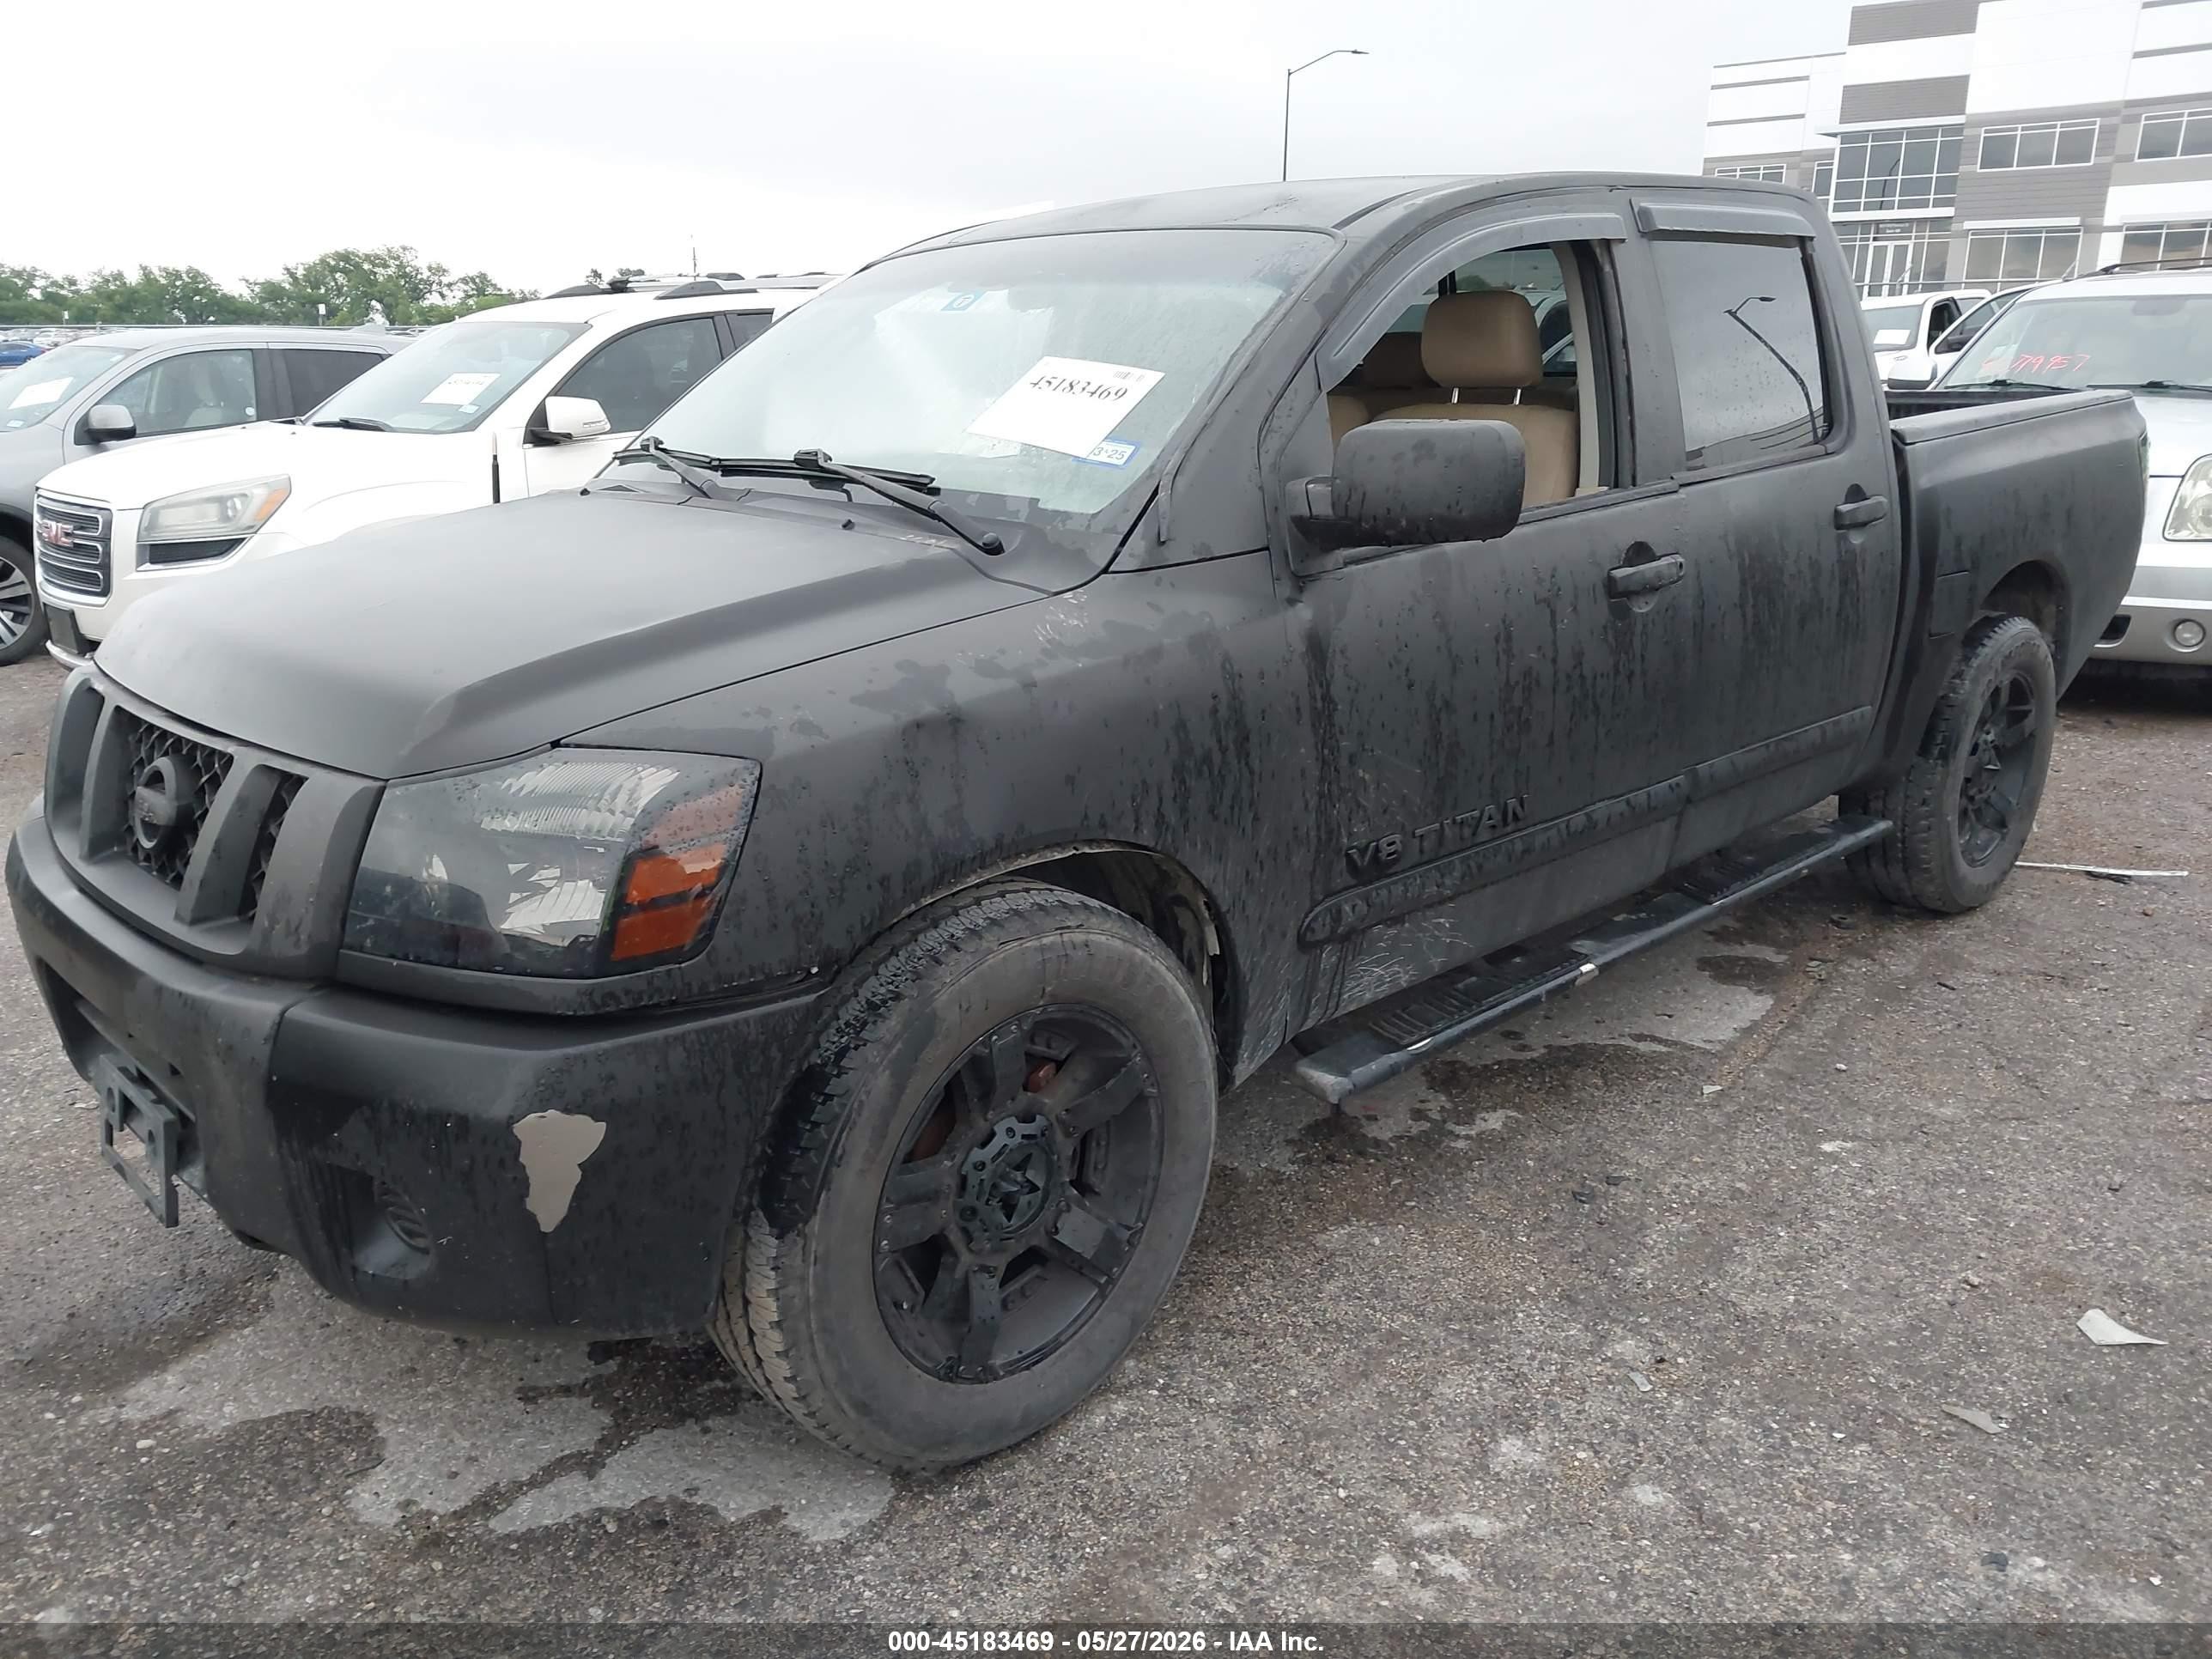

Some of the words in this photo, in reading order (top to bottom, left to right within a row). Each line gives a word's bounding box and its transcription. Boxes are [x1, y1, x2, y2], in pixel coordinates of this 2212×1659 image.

[1030, 375, 1127, 401] 45183469
[40, 519, 75, 549] GMC
[1345, 832, 1403, 872] V8
[1413, 793, 1531, 855] TITAN
